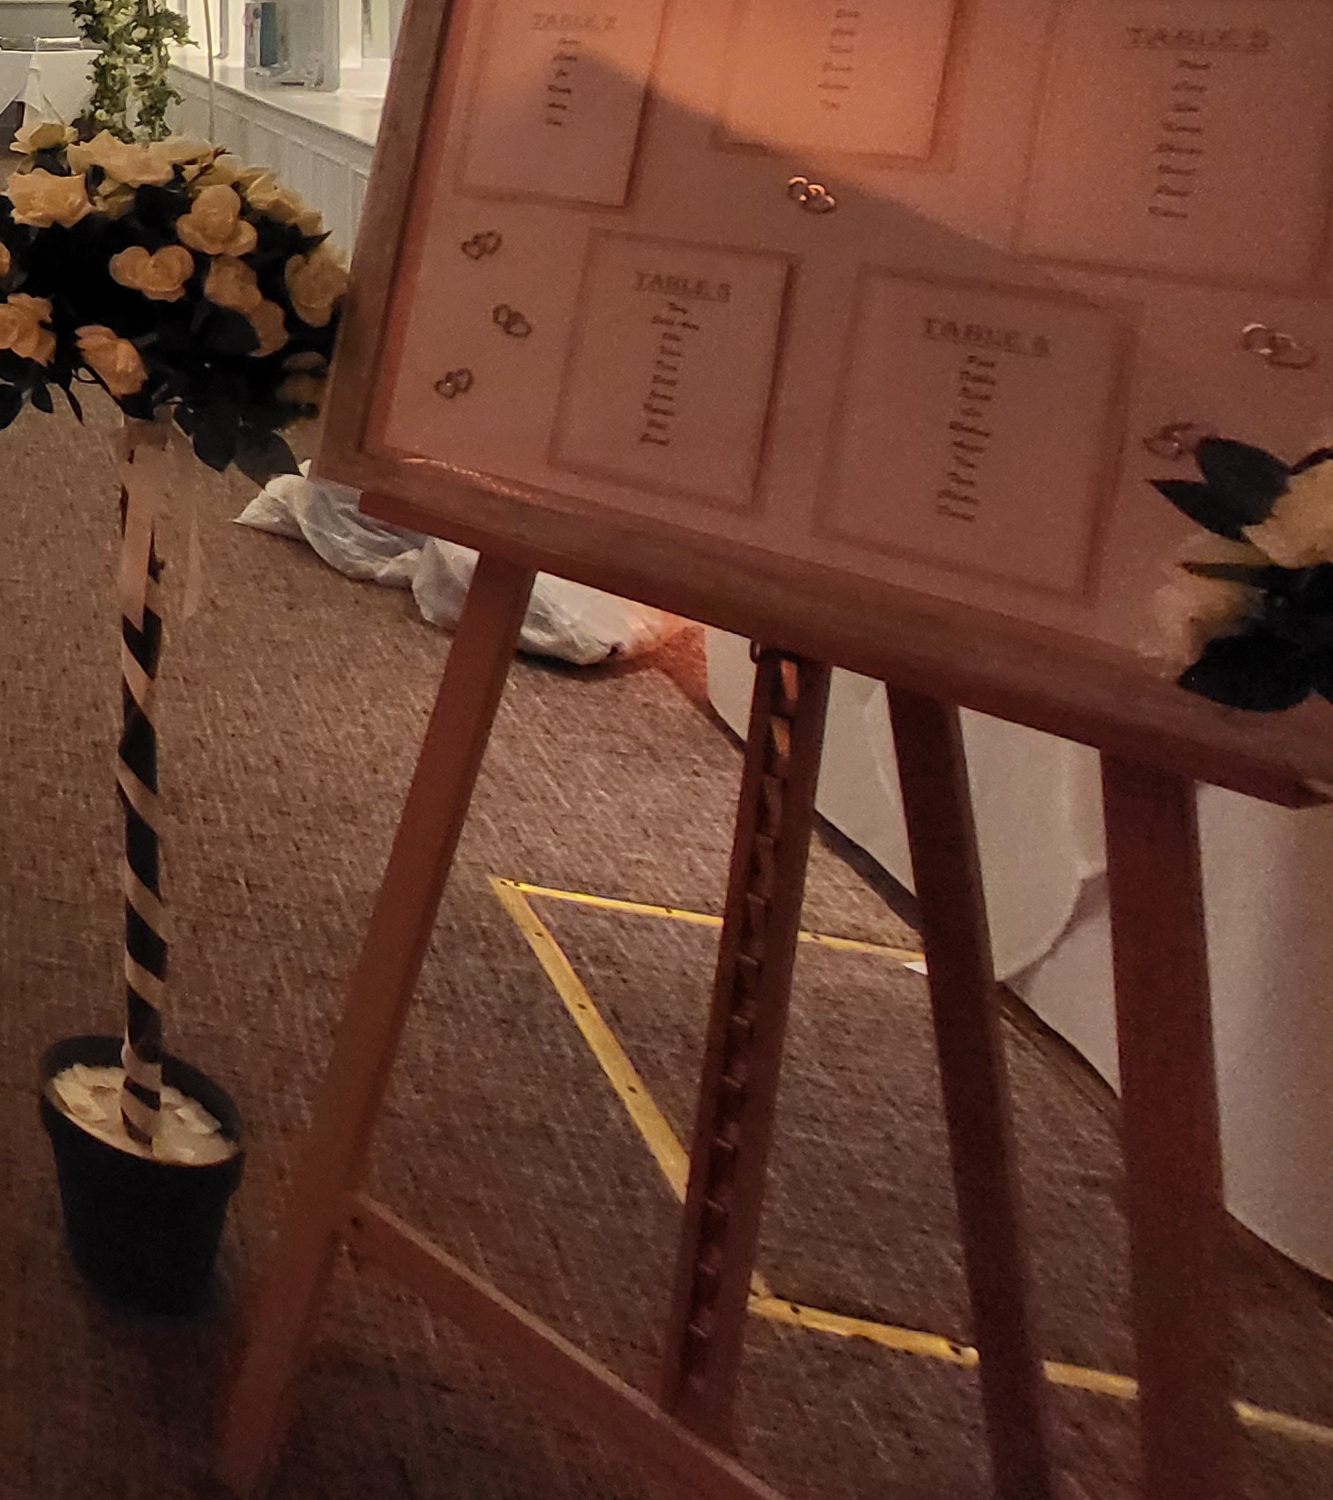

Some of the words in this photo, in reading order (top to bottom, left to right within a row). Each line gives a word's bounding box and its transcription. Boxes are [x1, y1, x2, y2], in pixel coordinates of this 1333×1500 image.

[533, 12, 596, 30] TABLE
[1127, 26, 1239, 49] TABLE
[635, 271, 709, 298] TABLE
[925, 318, 1021, 349] TABLE
